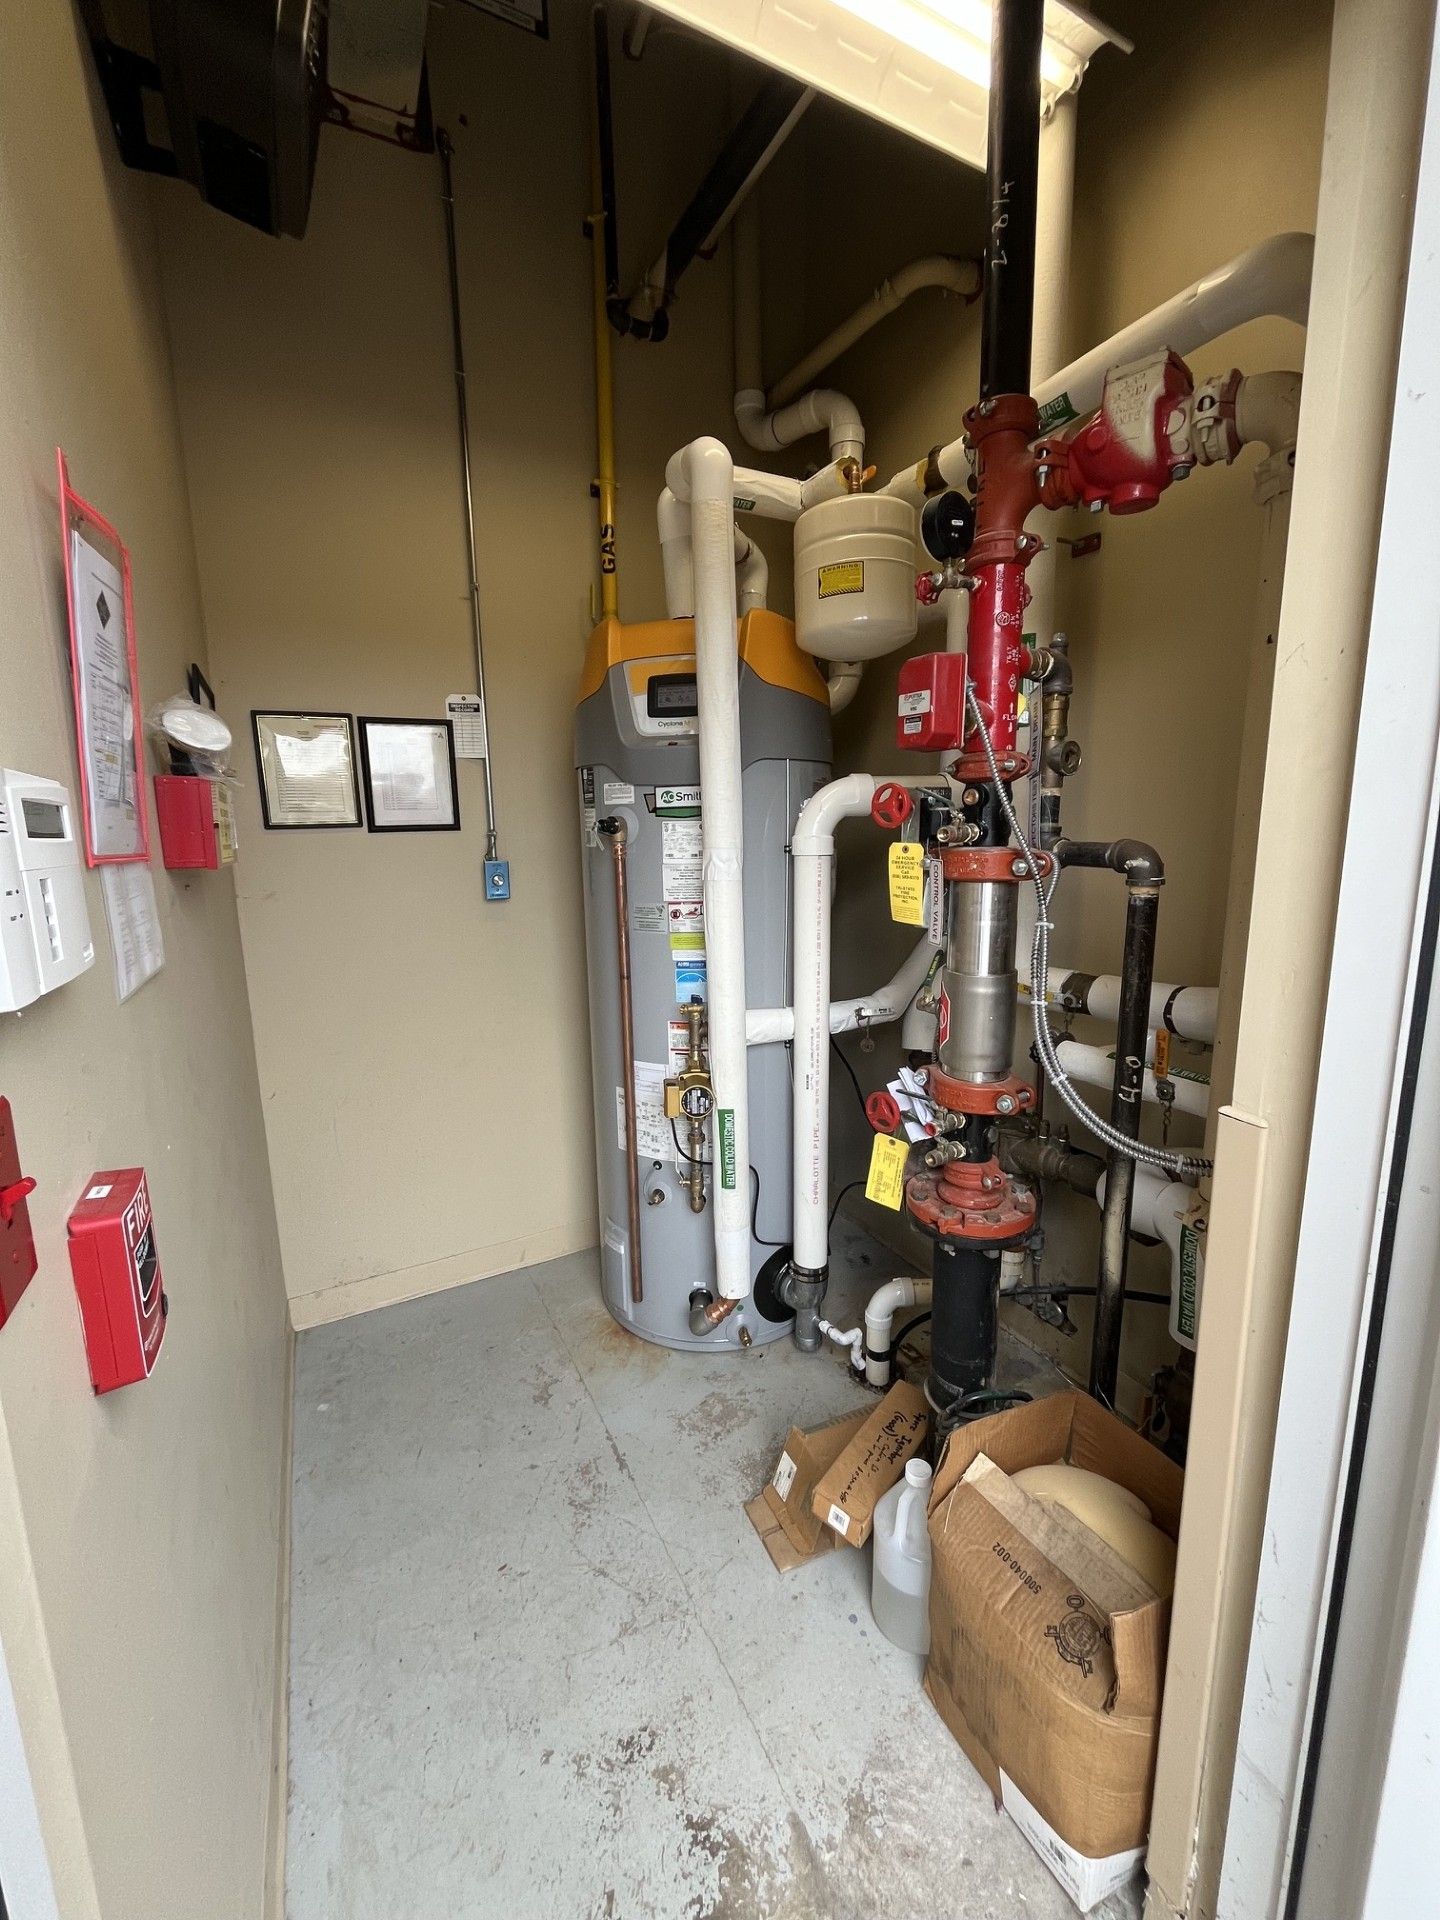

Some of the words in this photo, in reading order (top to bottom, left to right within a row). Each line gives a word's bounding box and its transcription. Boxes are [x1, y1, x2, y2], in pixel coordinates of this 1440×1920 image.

[1040, 396, 1066, 420] WATER
[600, 524, 616, 574] GAS
[724, 1114, 734, 1145] DOMESTIC
[725, 1146, 735, 1163] COLD
[726, 1164, 735, 1186] WATER
[126, 1178, 149, 1248] FIRE
[1184, 1231, 1199, 1275] DOMESTIC
[1183, 1276, 1197, 1300] COLD
[1182, 1301, 1196, 1333] WATER
[882, 1412, 908, 1437] (Good)
[992, 1542, 1042, 1594] 500040-002
